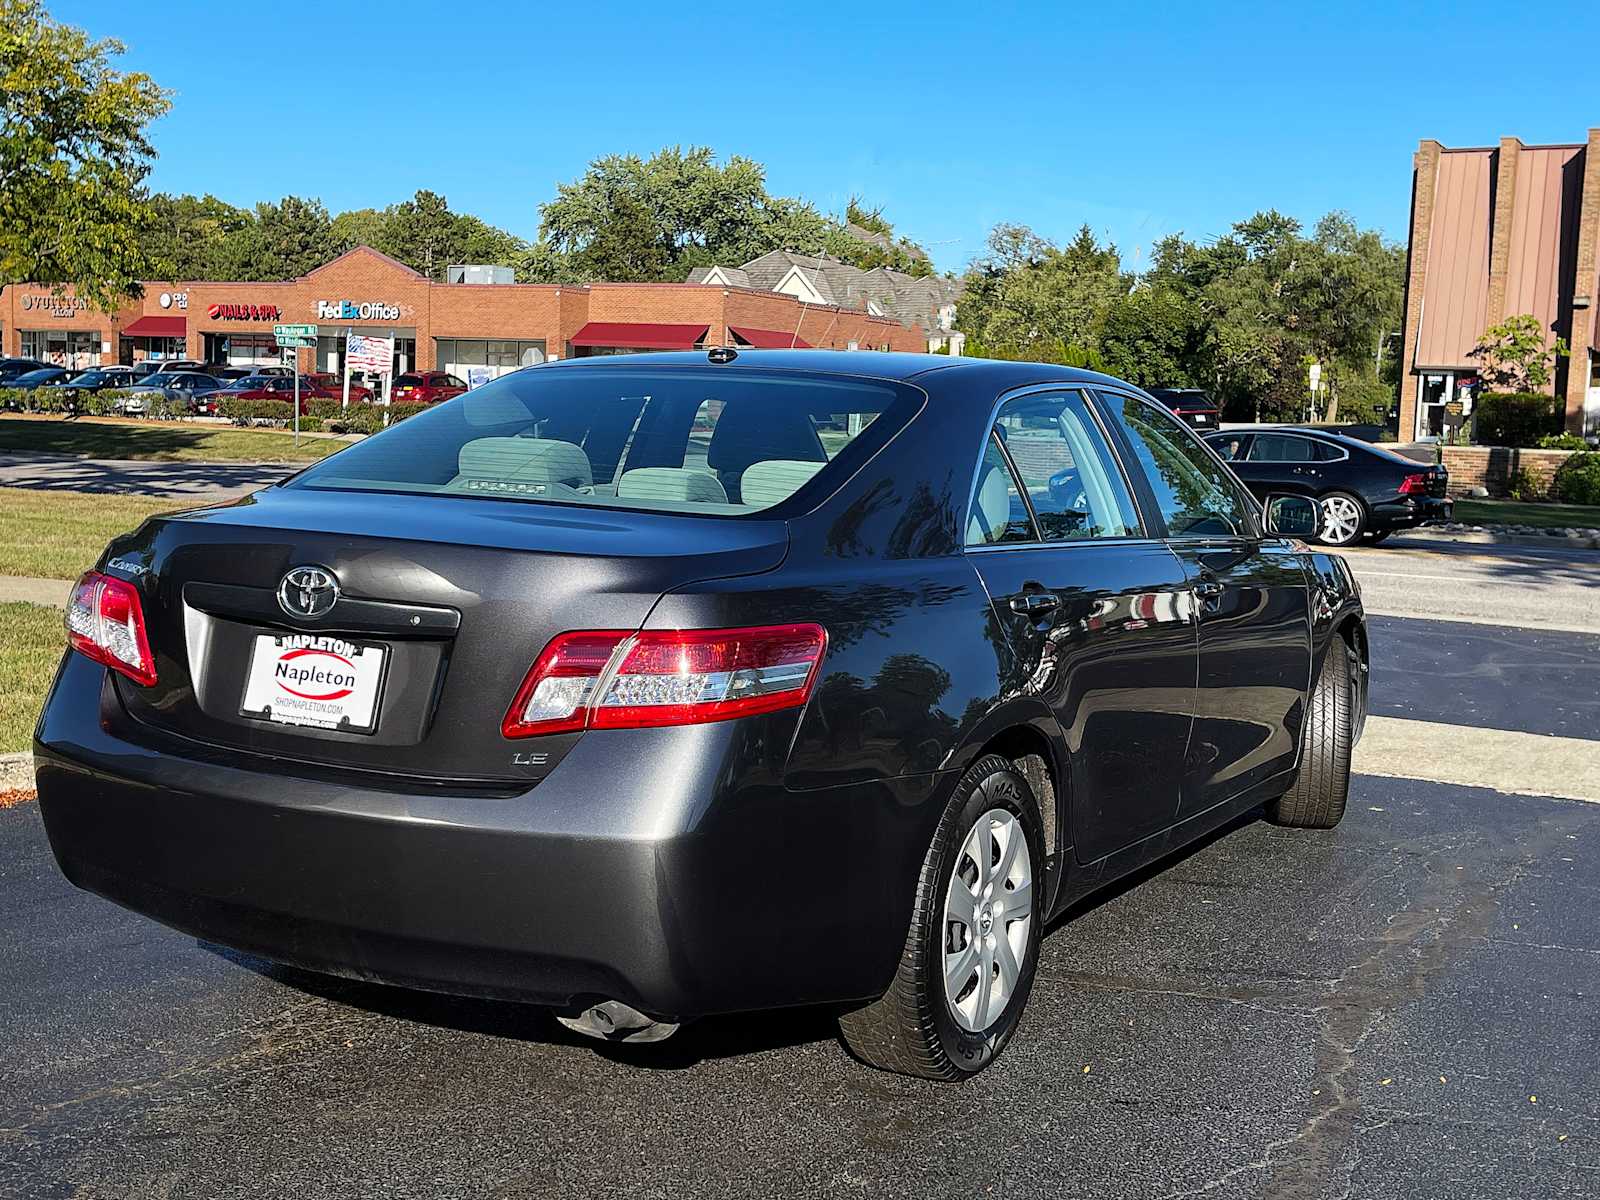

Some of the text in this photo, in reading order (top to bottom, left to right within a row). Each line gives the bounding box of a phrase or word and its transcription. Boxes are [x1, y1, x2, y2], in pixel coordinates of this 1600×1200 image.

[52, 309, 75, 318] SALON
[219, 304, 278, 319] NAILS & SPA
[318, 300, 400, 320] FedEx Office
[108, 557, 149, 576] CAMRY
[281, 634, 355, 659] NAPLETON
[275, 662, 355, 687] Napleton
[274, 696, 343, 715] SHOPNAPLETON.COM
[513, 753, 549, 765] LE
